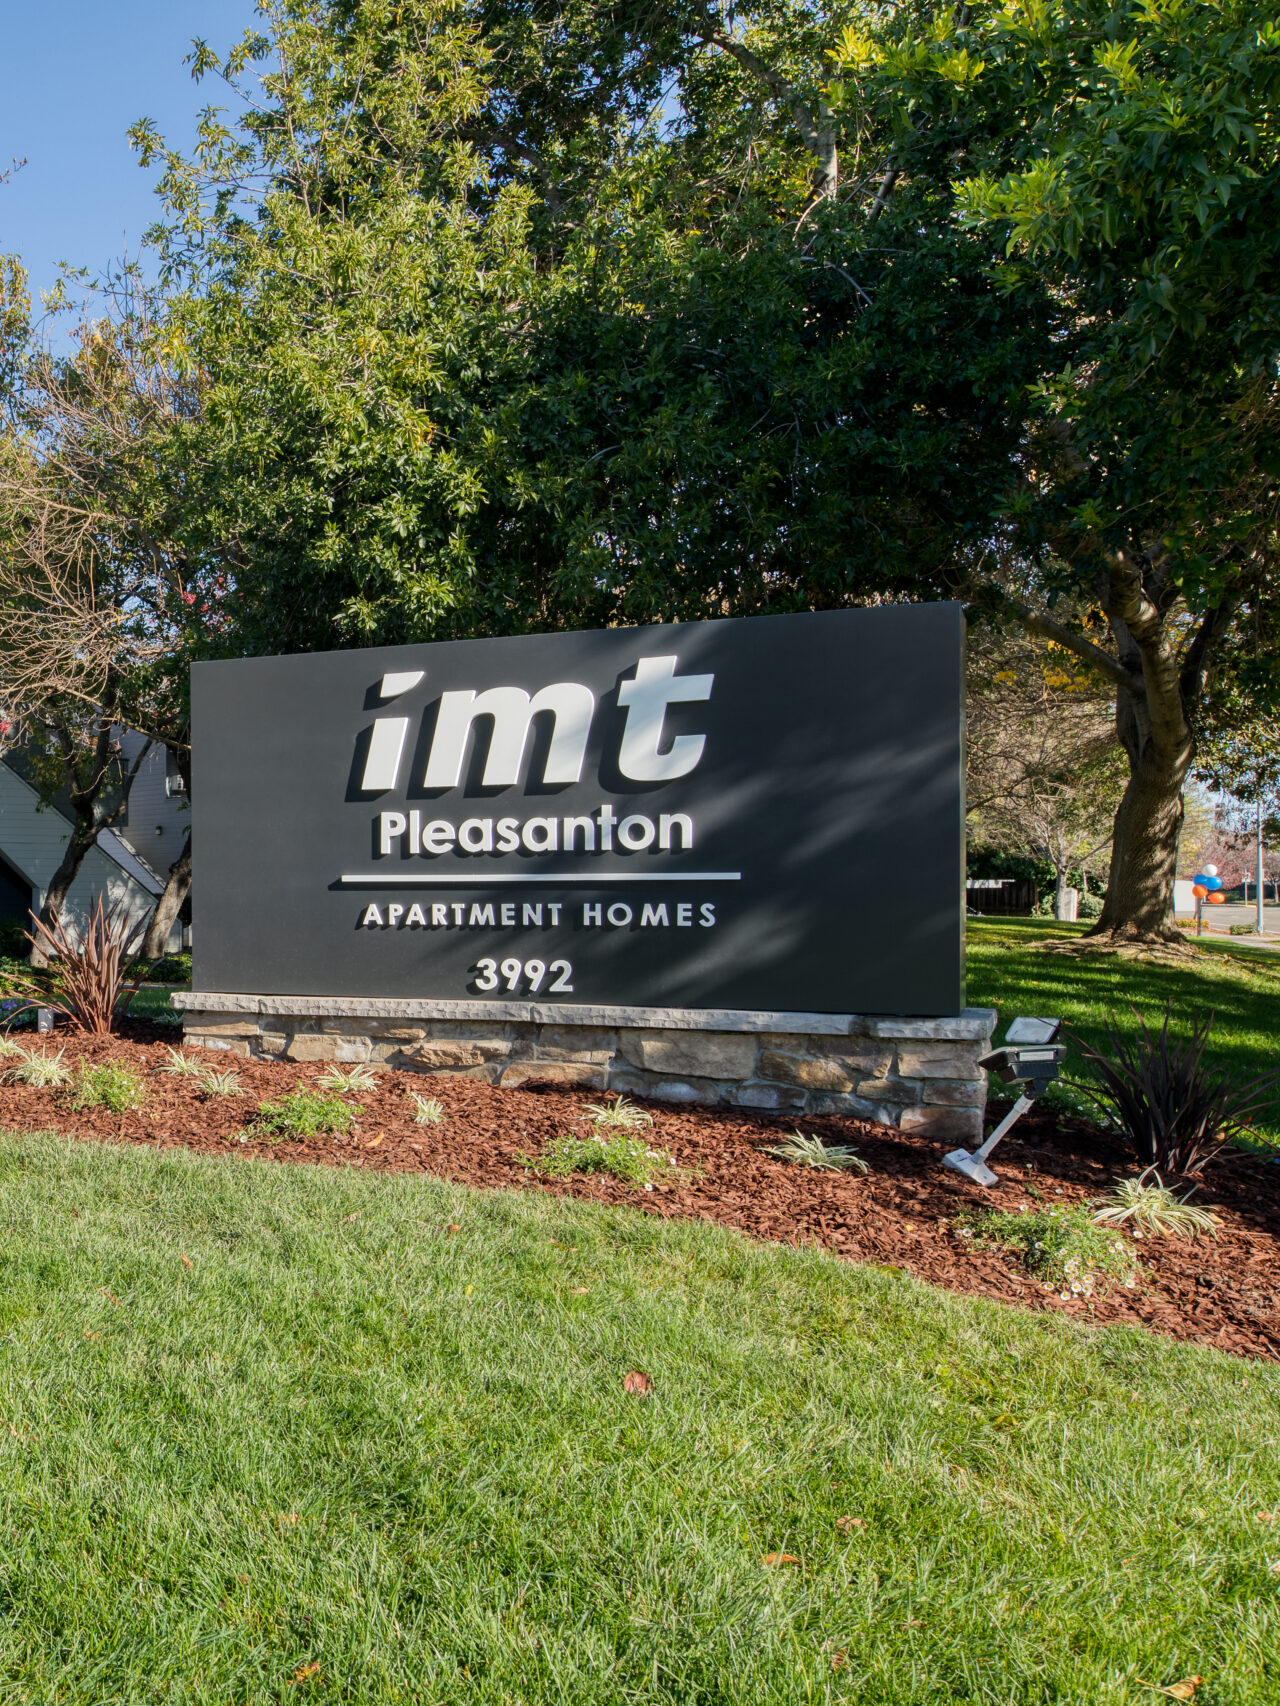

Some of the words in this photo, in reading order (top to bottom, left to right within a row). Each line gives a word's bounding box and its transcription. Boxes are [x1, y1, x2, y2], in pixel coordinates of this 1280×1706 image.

[361, 654, 715, 791] imt
[380, 804, 695, 855] Pleasanton
[362, 902, 562, 926] APARTMENT
[583, 902, 716, 927] HOMES
[475, 957, 574, 992] 3992
